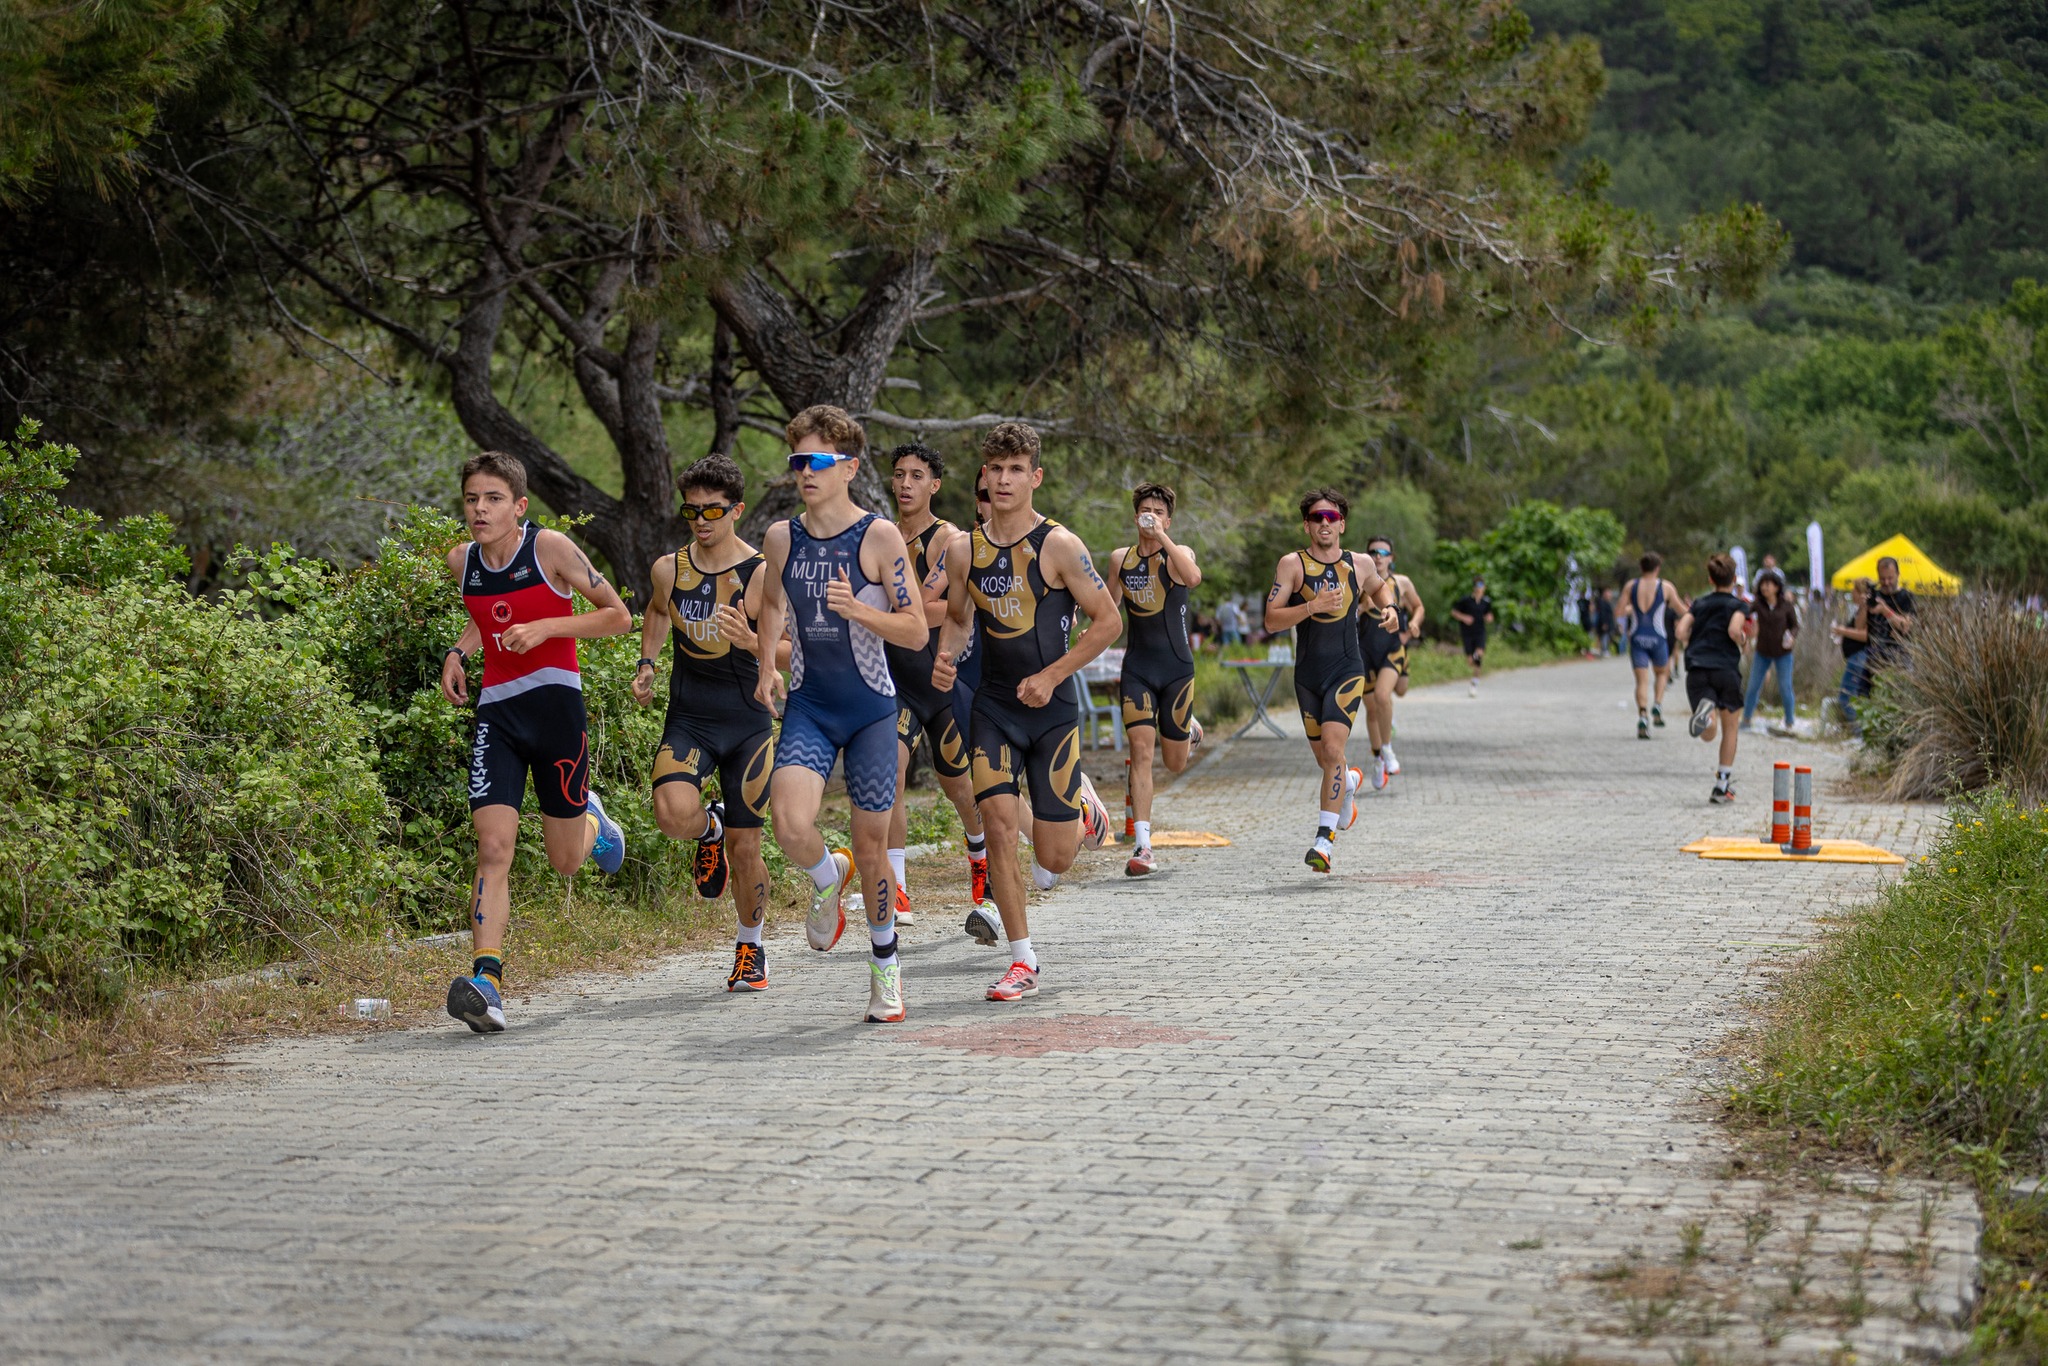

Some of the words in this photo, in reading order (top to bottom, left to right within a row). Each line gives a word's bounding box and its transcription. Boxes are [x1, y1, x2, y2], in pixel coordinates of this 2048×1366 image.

[790, 560, 850, 580] MUTLU
[924, 549, 946, 590] 42
[892, 556, 912, 608] 38
[980, 575, 1025, 597] KOŞAR
[1125, 575, 1156, 590] SERBEST
[987, 597, 1024, 618] TUR
[1129, 590, 1156, 604] TUR
[682, 619, 720, 642] TUR
[1329, 764, 1343, 800] 29
[751, 882, 765, 922] 30
[877, 878, 889, 922] 38
